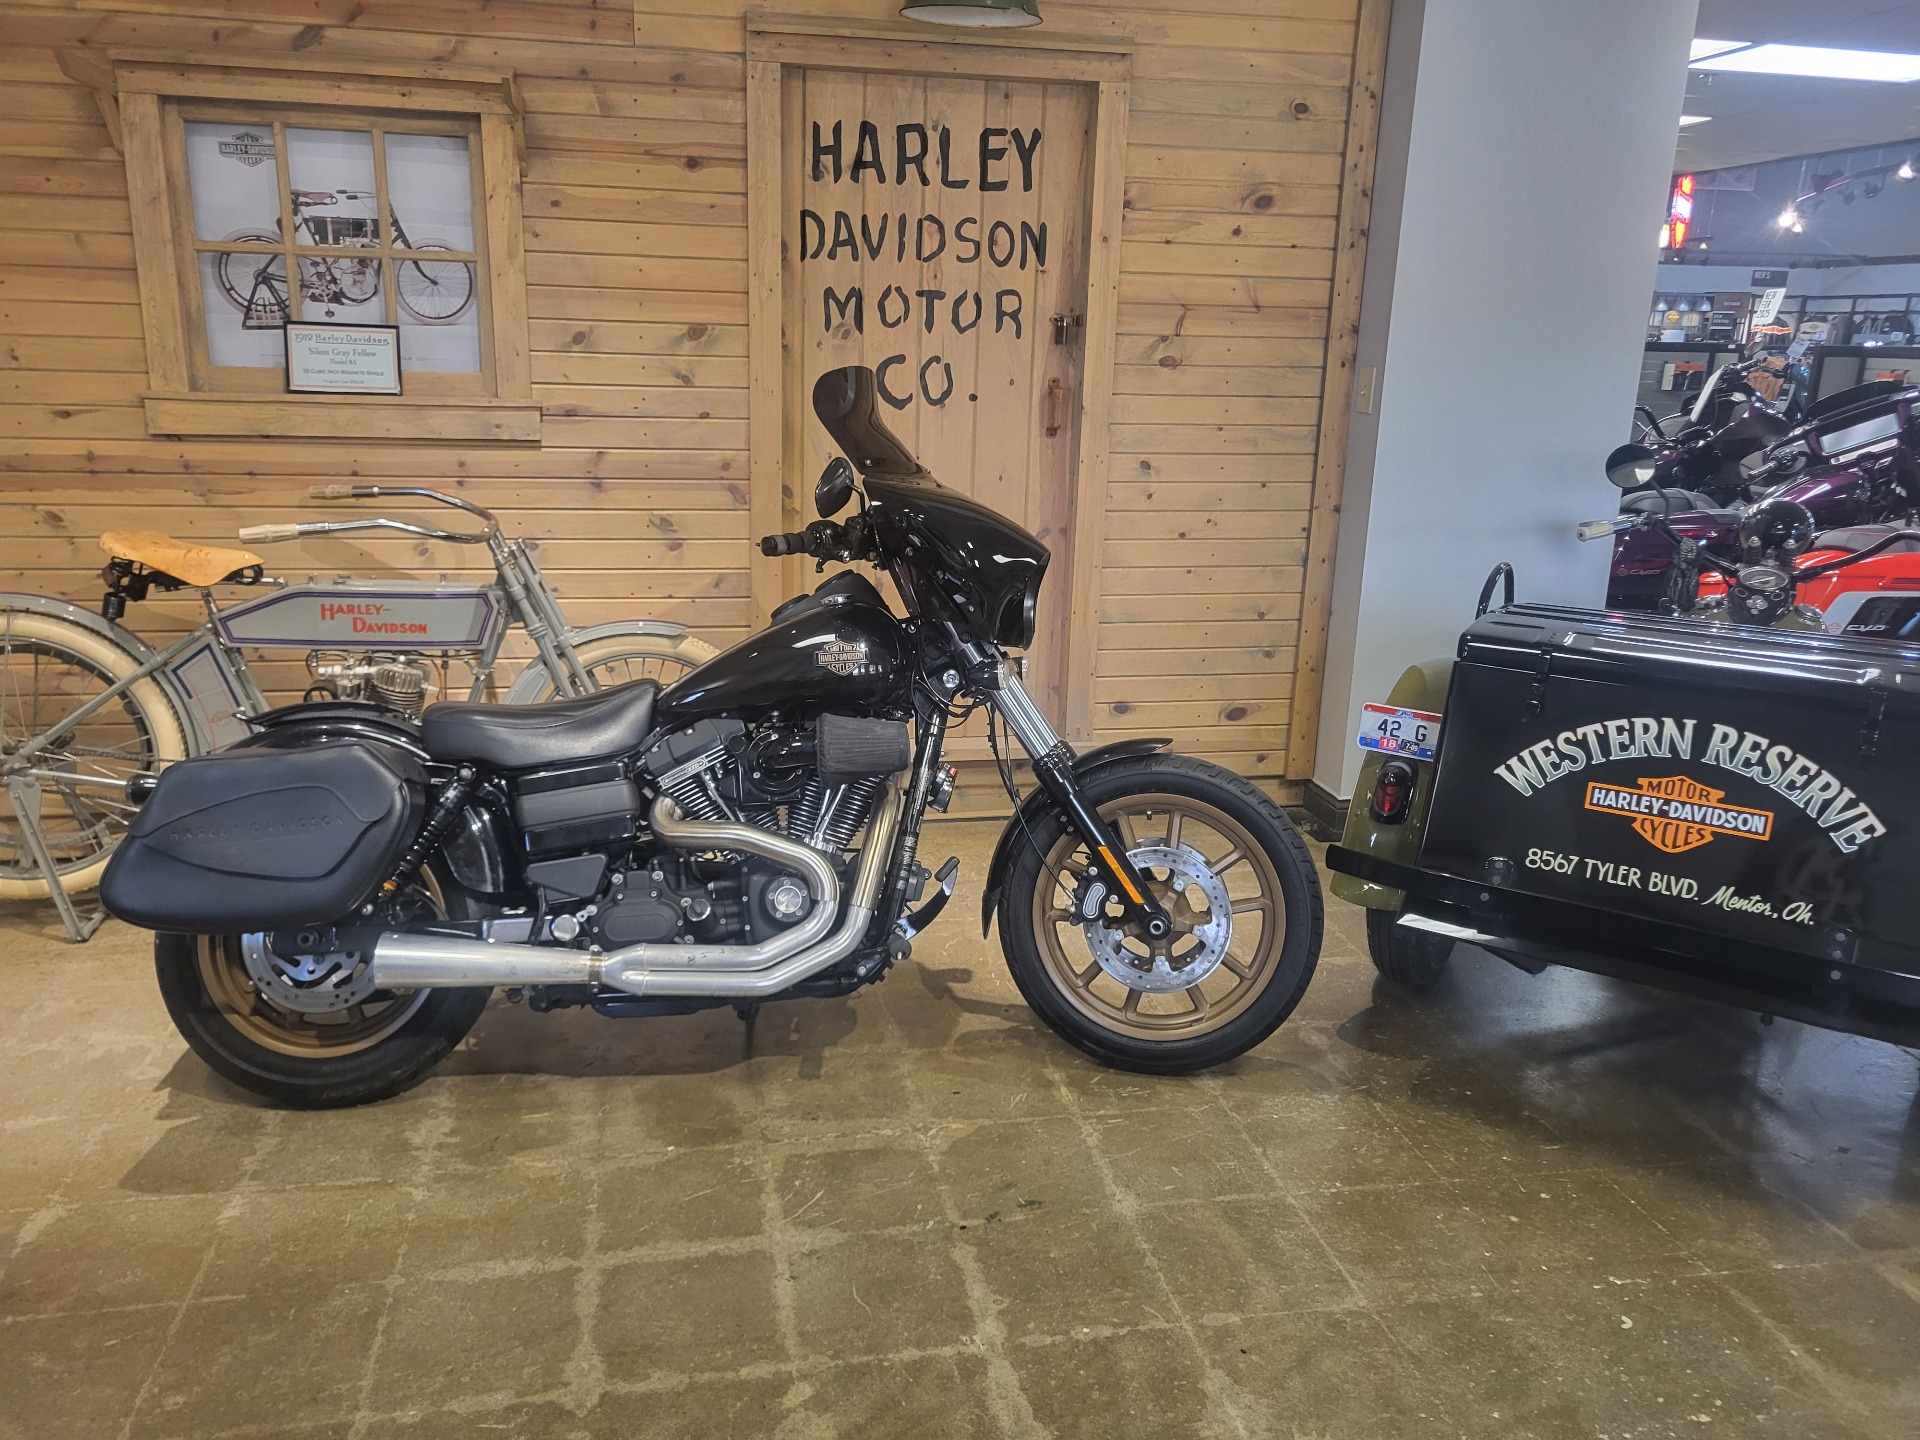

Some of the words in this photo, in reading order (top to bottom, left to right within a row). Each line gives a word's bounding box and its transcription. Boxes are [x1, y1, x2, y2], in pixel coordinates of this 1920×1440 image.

[812, 119, 1042, 192] HARLEY
[800, 209, 1047, 271] DAVIDSON
[823, 284, 1022, 339] MOTOR
[295, 333, 313, 343] 1912
[315, 334, 345, 344] Harley
[346, 335, 389, 346] Davidson
[332, 348, 350, 357] Gray
[353, 349, 377, 357] Fellow
[876, 354, 978, 410] CO.
[352, 617, 427, 634] DAVIDSON
[820, 652, 864, 663] HARLEY-DAVIDSON
[830, 644, 853, 652] MOTOR
[831, 662, 854, 673] CYCLES
[1377, 718, 1402, 739] 42
[1414, 724, 1428, 742] G
[1381, 738, 1397, 748] 18
[1493, 717, 1697, 797] WESTERN
[1700, 723, 1887, 854] RESERVE
[1646, 778, 1711, 802] MOTOR
[1592, 788, 1766, 834] HARLEY-DAVIDSON
[1640, 817, 1706, 850] CYCLES
[1525, 848, 1579, 875] 8567
[1584, 858, 1642, 889] TYLER
[1648, 871, 1699, 901] BLVD.
[1700, 885, 1778, 919] Mentor,
[1782, 901, 1814, 925] Oh.
